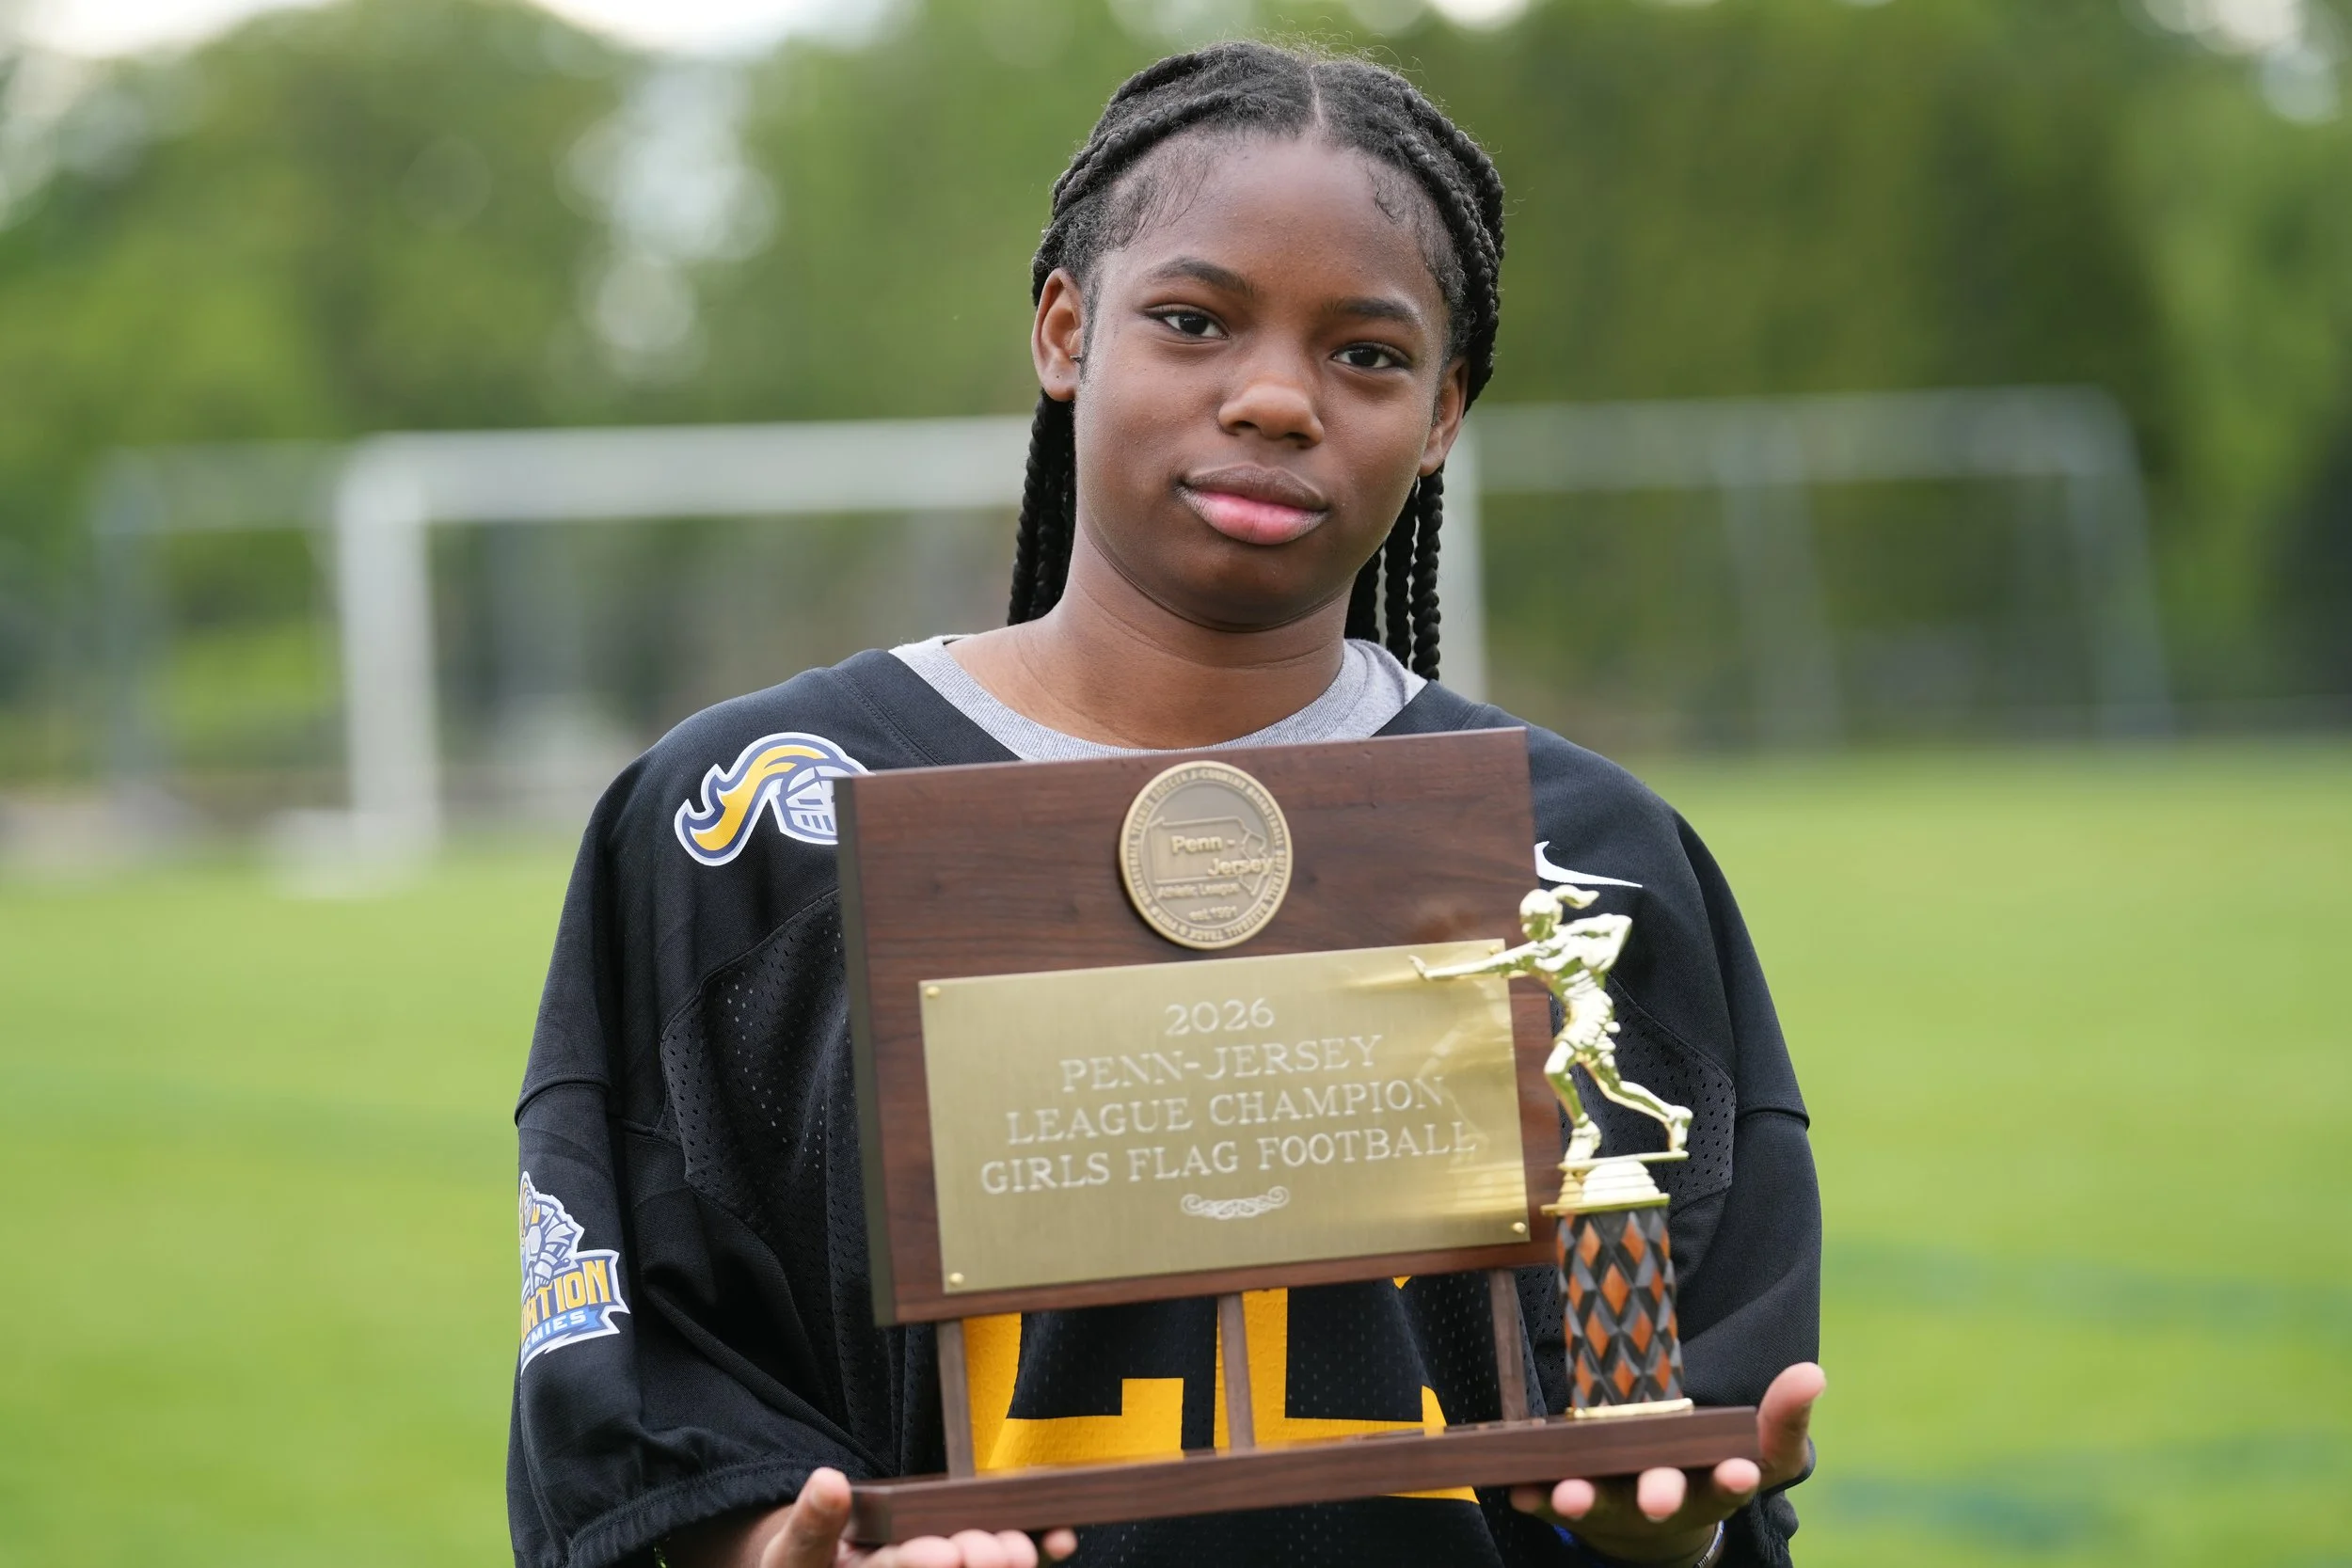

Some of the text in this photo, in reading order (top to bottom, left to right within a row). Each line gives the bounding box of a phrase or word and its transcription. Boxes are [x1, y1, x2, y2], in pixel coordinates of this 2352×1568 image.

[1171, 835, 1223, 855] Penn
[1208, 857, 1272, 877] Jersey
[1165, 998, 1275, 1036] 2026
[1059, 1035, 1382, 1092] PENN-JERSEY
[1006, 1077, 1444, 1145] LEAGUE CHAMPION
[980, 1121, 1477, 1194] GIRLS FLAG FOOTBALL
